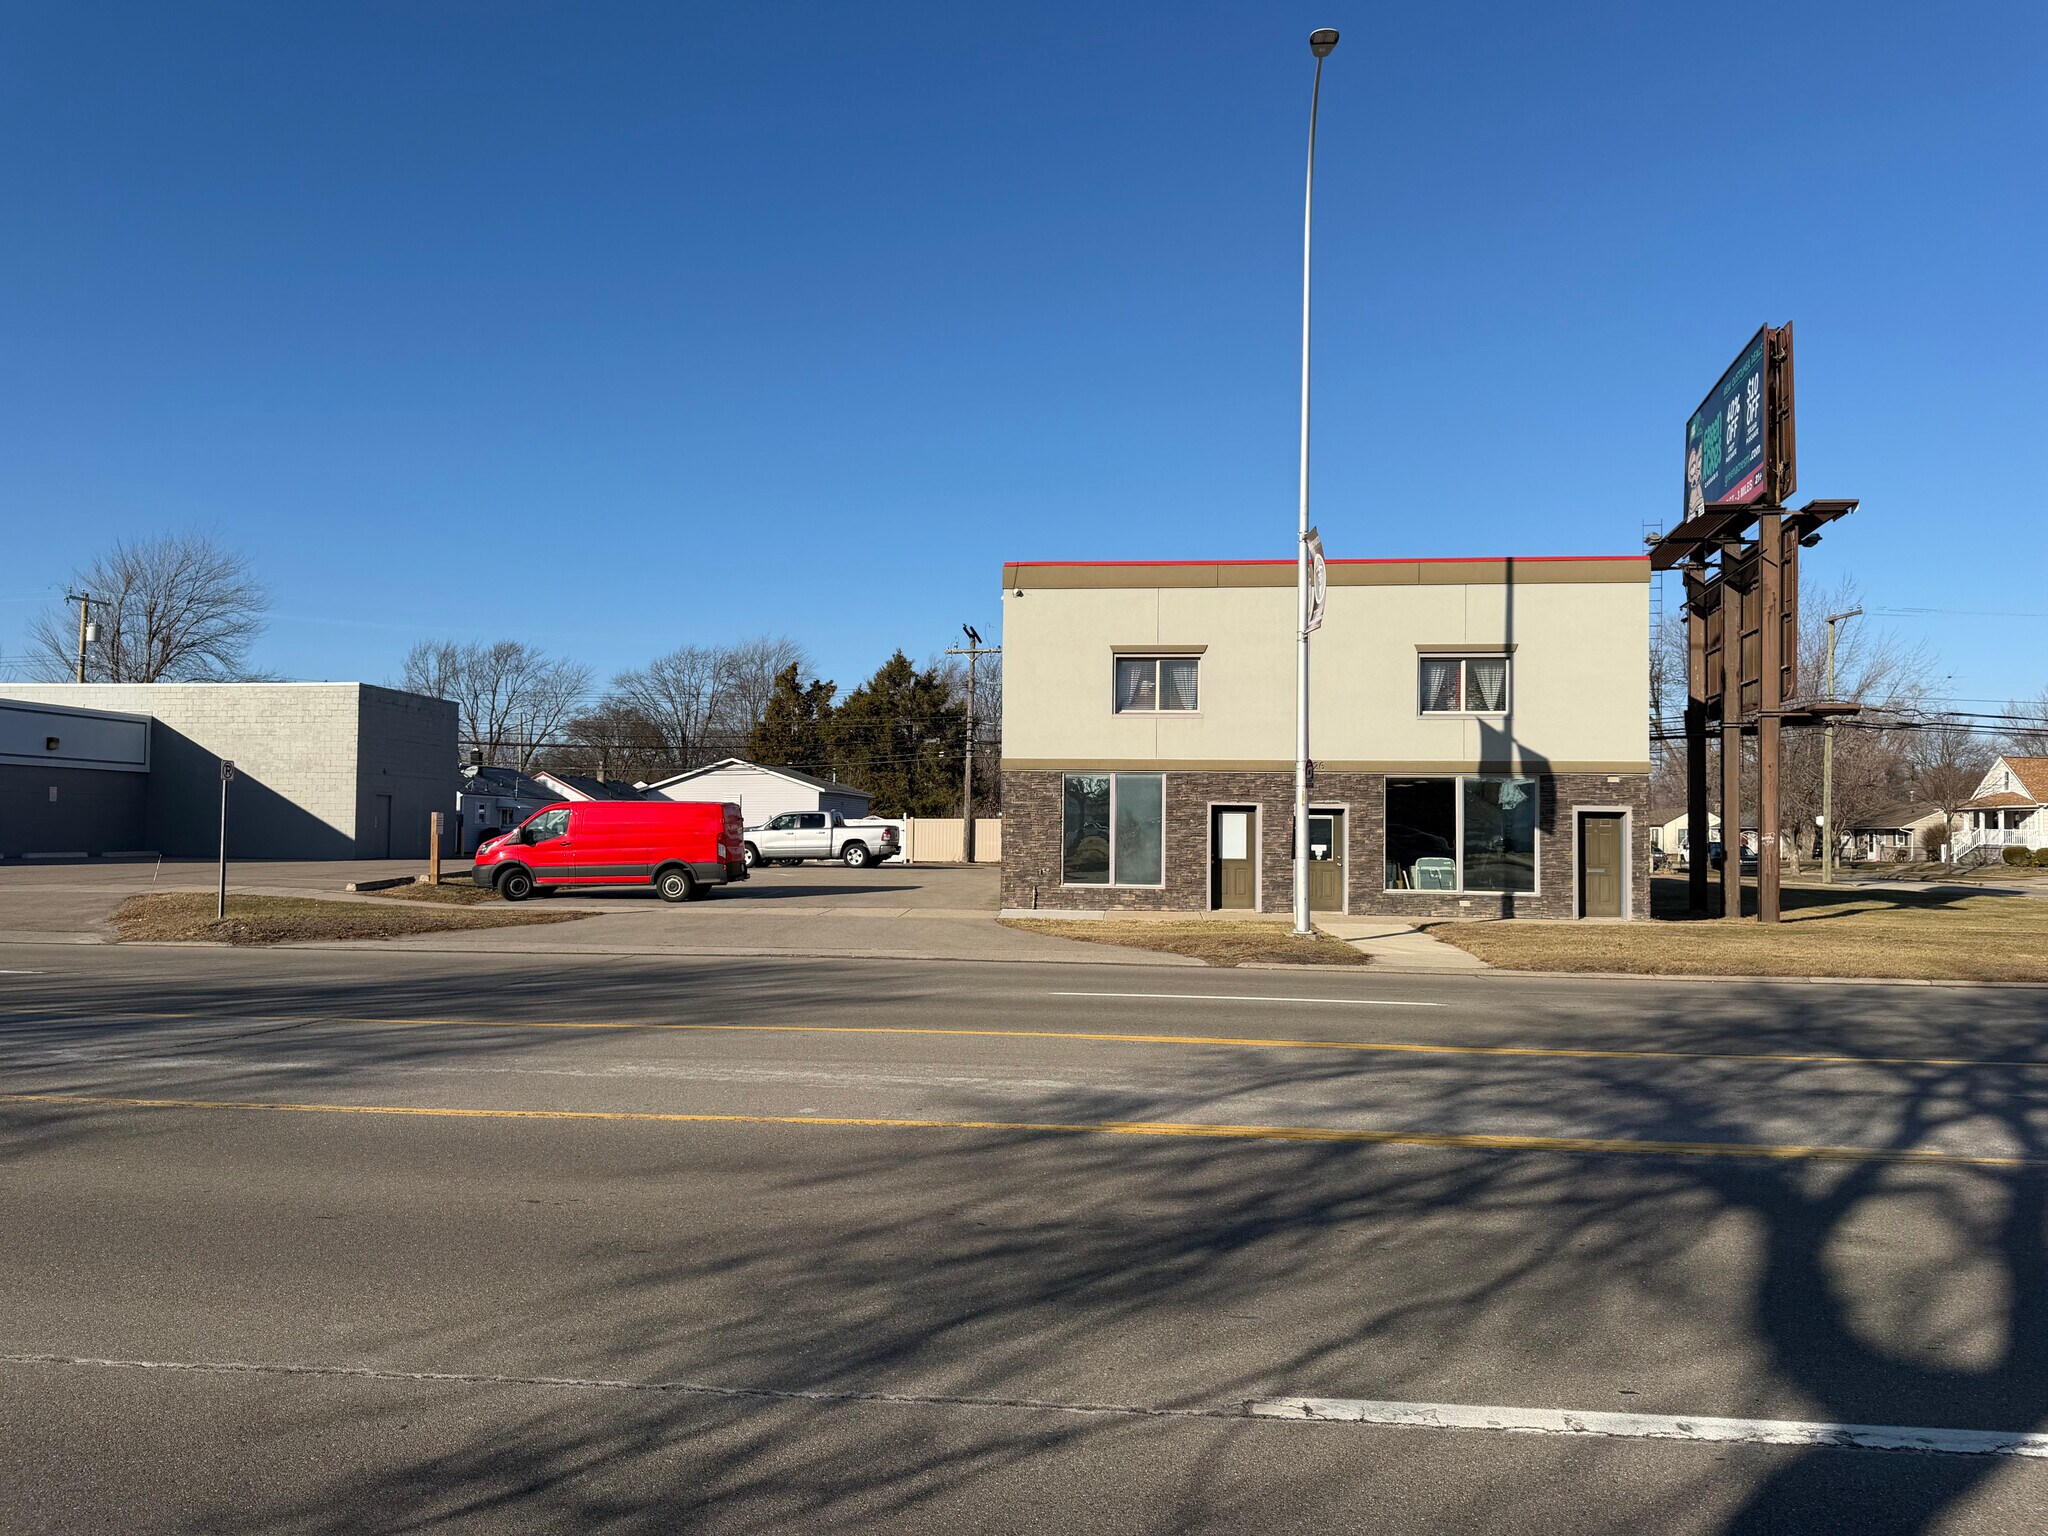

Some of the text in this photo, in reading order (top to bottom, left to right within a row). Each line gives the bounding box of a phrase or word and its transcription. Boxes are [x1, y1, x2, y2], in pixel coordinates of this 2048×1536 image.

[1747, 372, 1759, 399] $10
[1727, 393, 1740, 423] 40%
[1747, 393, 1760, 425] OFF
[1727, 415, 1738, 445] OFF
[1741, 479, 1752, 497] MILES
